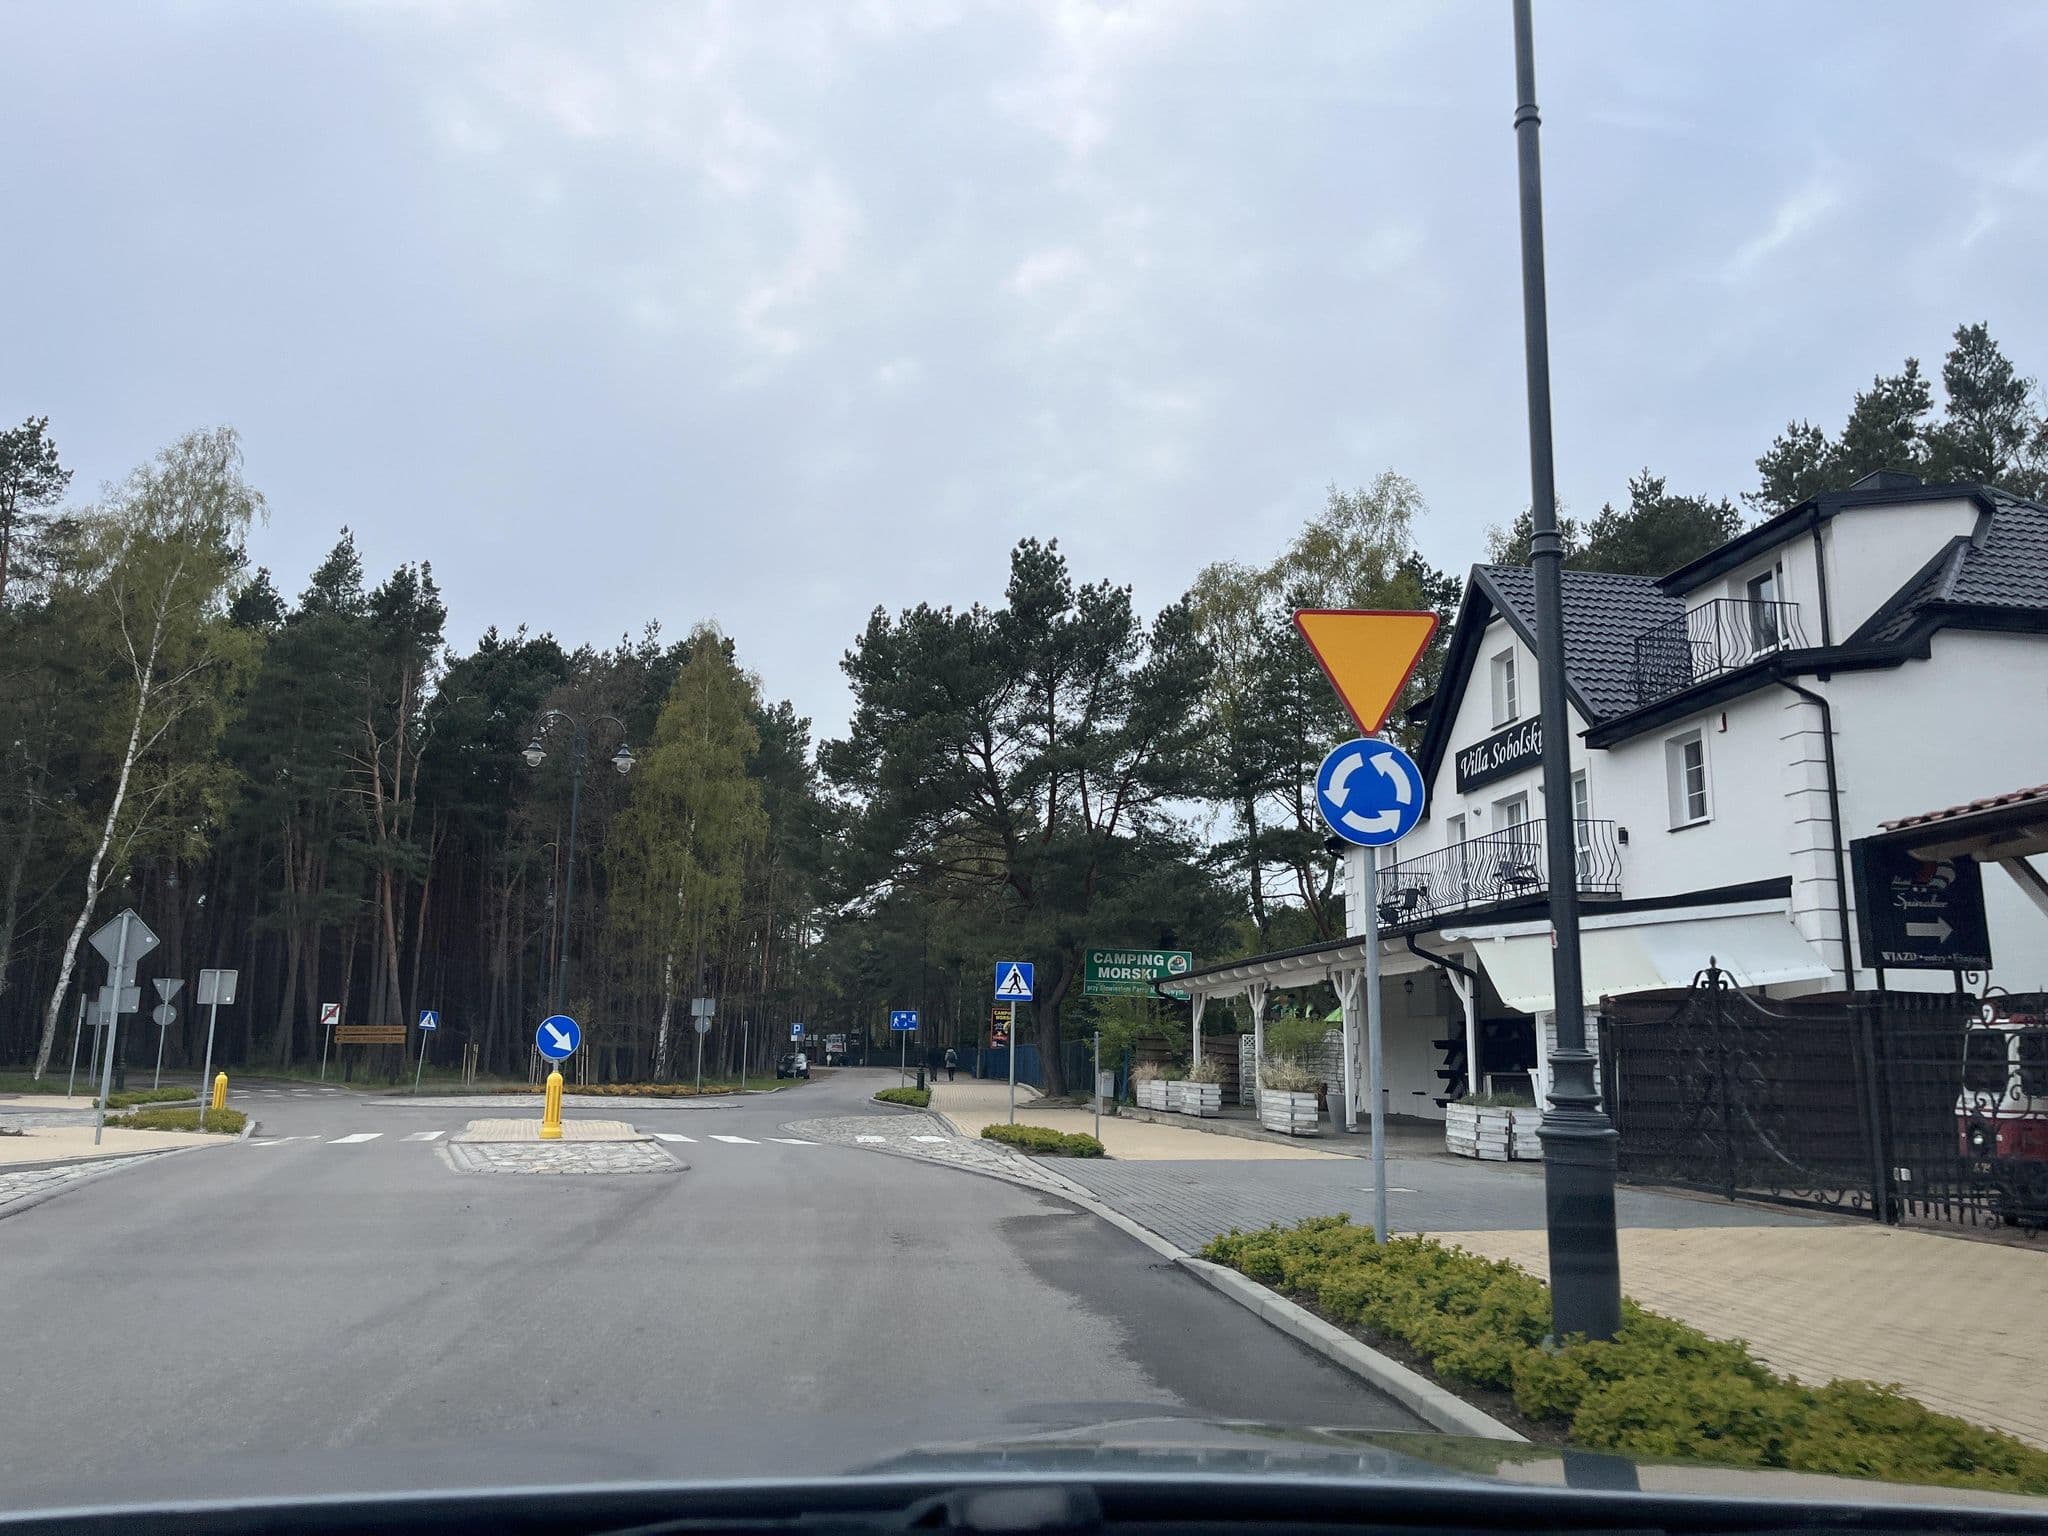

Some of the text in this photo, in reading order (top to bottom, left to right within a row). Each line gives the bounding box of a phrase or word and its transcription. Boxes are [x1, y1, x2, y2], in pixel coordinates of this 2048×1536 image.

[1460, 721, 1543, 779] Villa Sobolski
[1093, 952, 1164, 967] CAMPING
[1881, 951, 1917, 962] WJAZD
[1098, 967, 1158, 980] MORSKI
[793, 1024, 801, 1034] P
